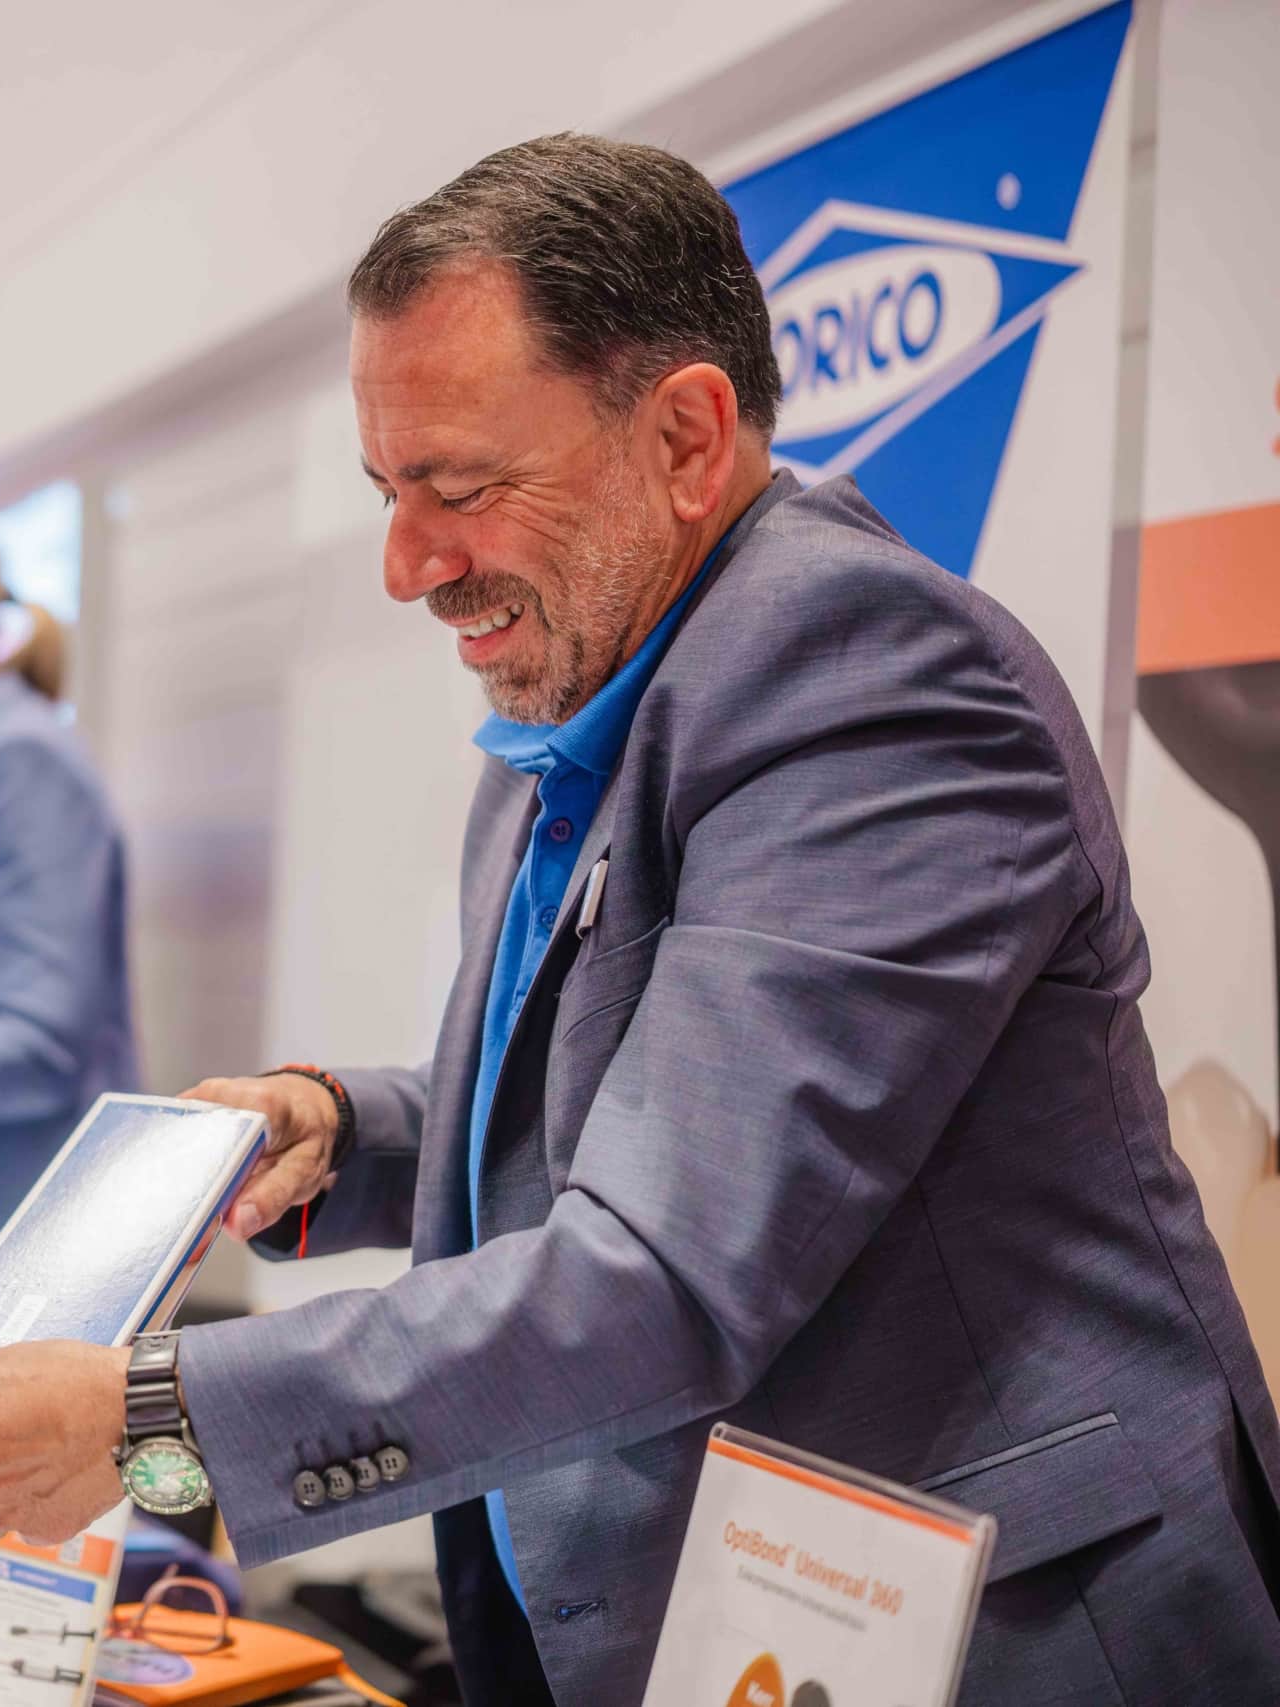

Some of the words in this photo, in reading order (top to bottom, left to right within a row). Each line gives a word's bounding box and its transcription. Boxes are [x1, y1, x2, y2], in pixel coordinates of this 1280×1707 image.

[775, 271, 941, 394] ORICO
[794, 1550, 869, 1601] Universal
[870, 1579, 904, 1617] 360
